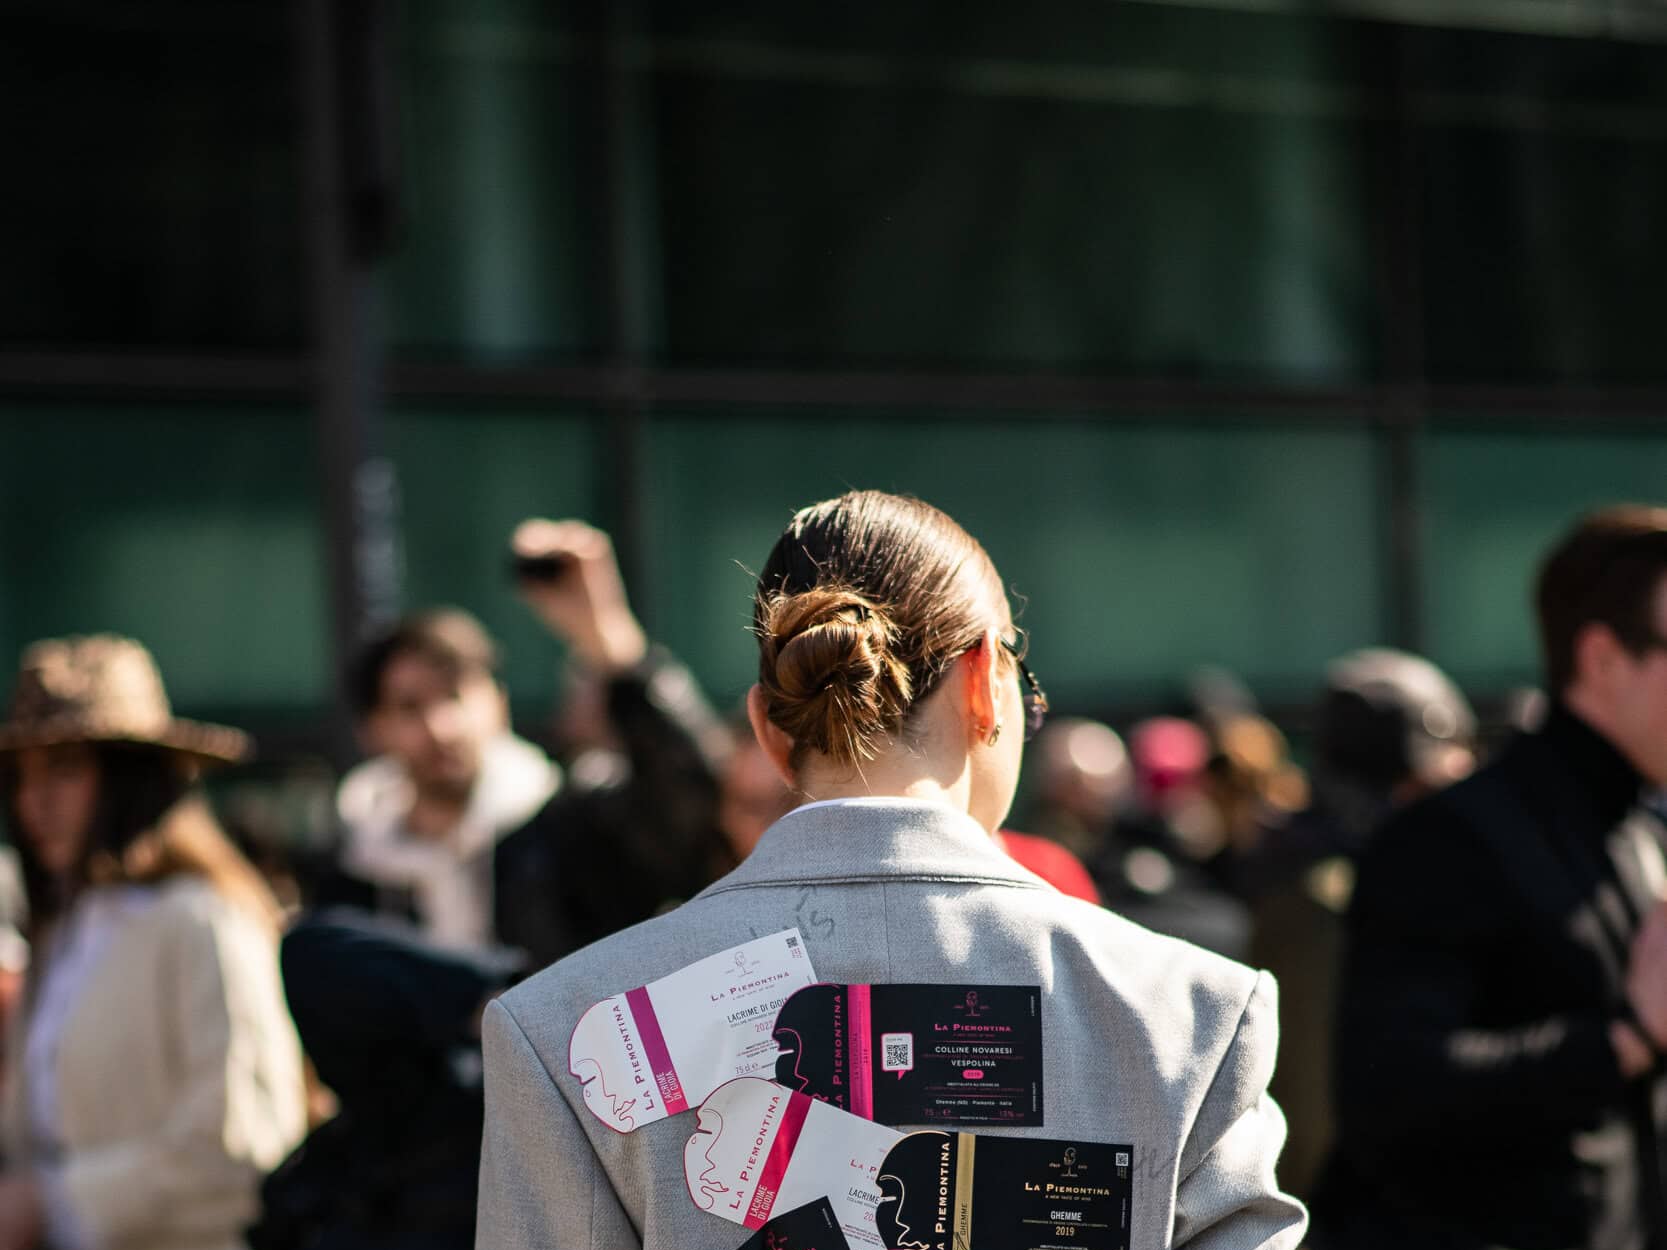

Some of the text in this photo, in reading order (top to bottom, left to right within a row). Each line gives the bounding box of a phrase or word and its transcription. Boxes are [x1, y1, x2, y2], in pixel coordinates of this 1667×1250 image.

[727, 1004, 759, 1023] LACRIME
[761, 1002, 768, 1013] DI
[934, 1023, 1013, 1032] LA PIEMONTINA
[833, 995, 843, 1086] PIEMONTINA
[935, 1046, 969, 1054] COLLINE
[612, 1004, 655, 1111] LA PIEMONTINA
[656, 1071, 672, 1105] LACRIME
[729, 1095, 780, 1210] LA PIEMONTINA
[849, 1187, 881, 1205] LACRIME
[935, 1141, 950, 1234] PIEMONTINA
[1025, 1182, 1110, 1196] LA PIEMONTINA
[750, 1184, 768, 1217] LACRIME
[761, 1191, 776, 1213] GIOIA
[960, 1201, 968, 1235] GHEMME
[1050, 1211, 1083, 1221] GHEMME
[1055, 1226, 1075, 1236] 2019
